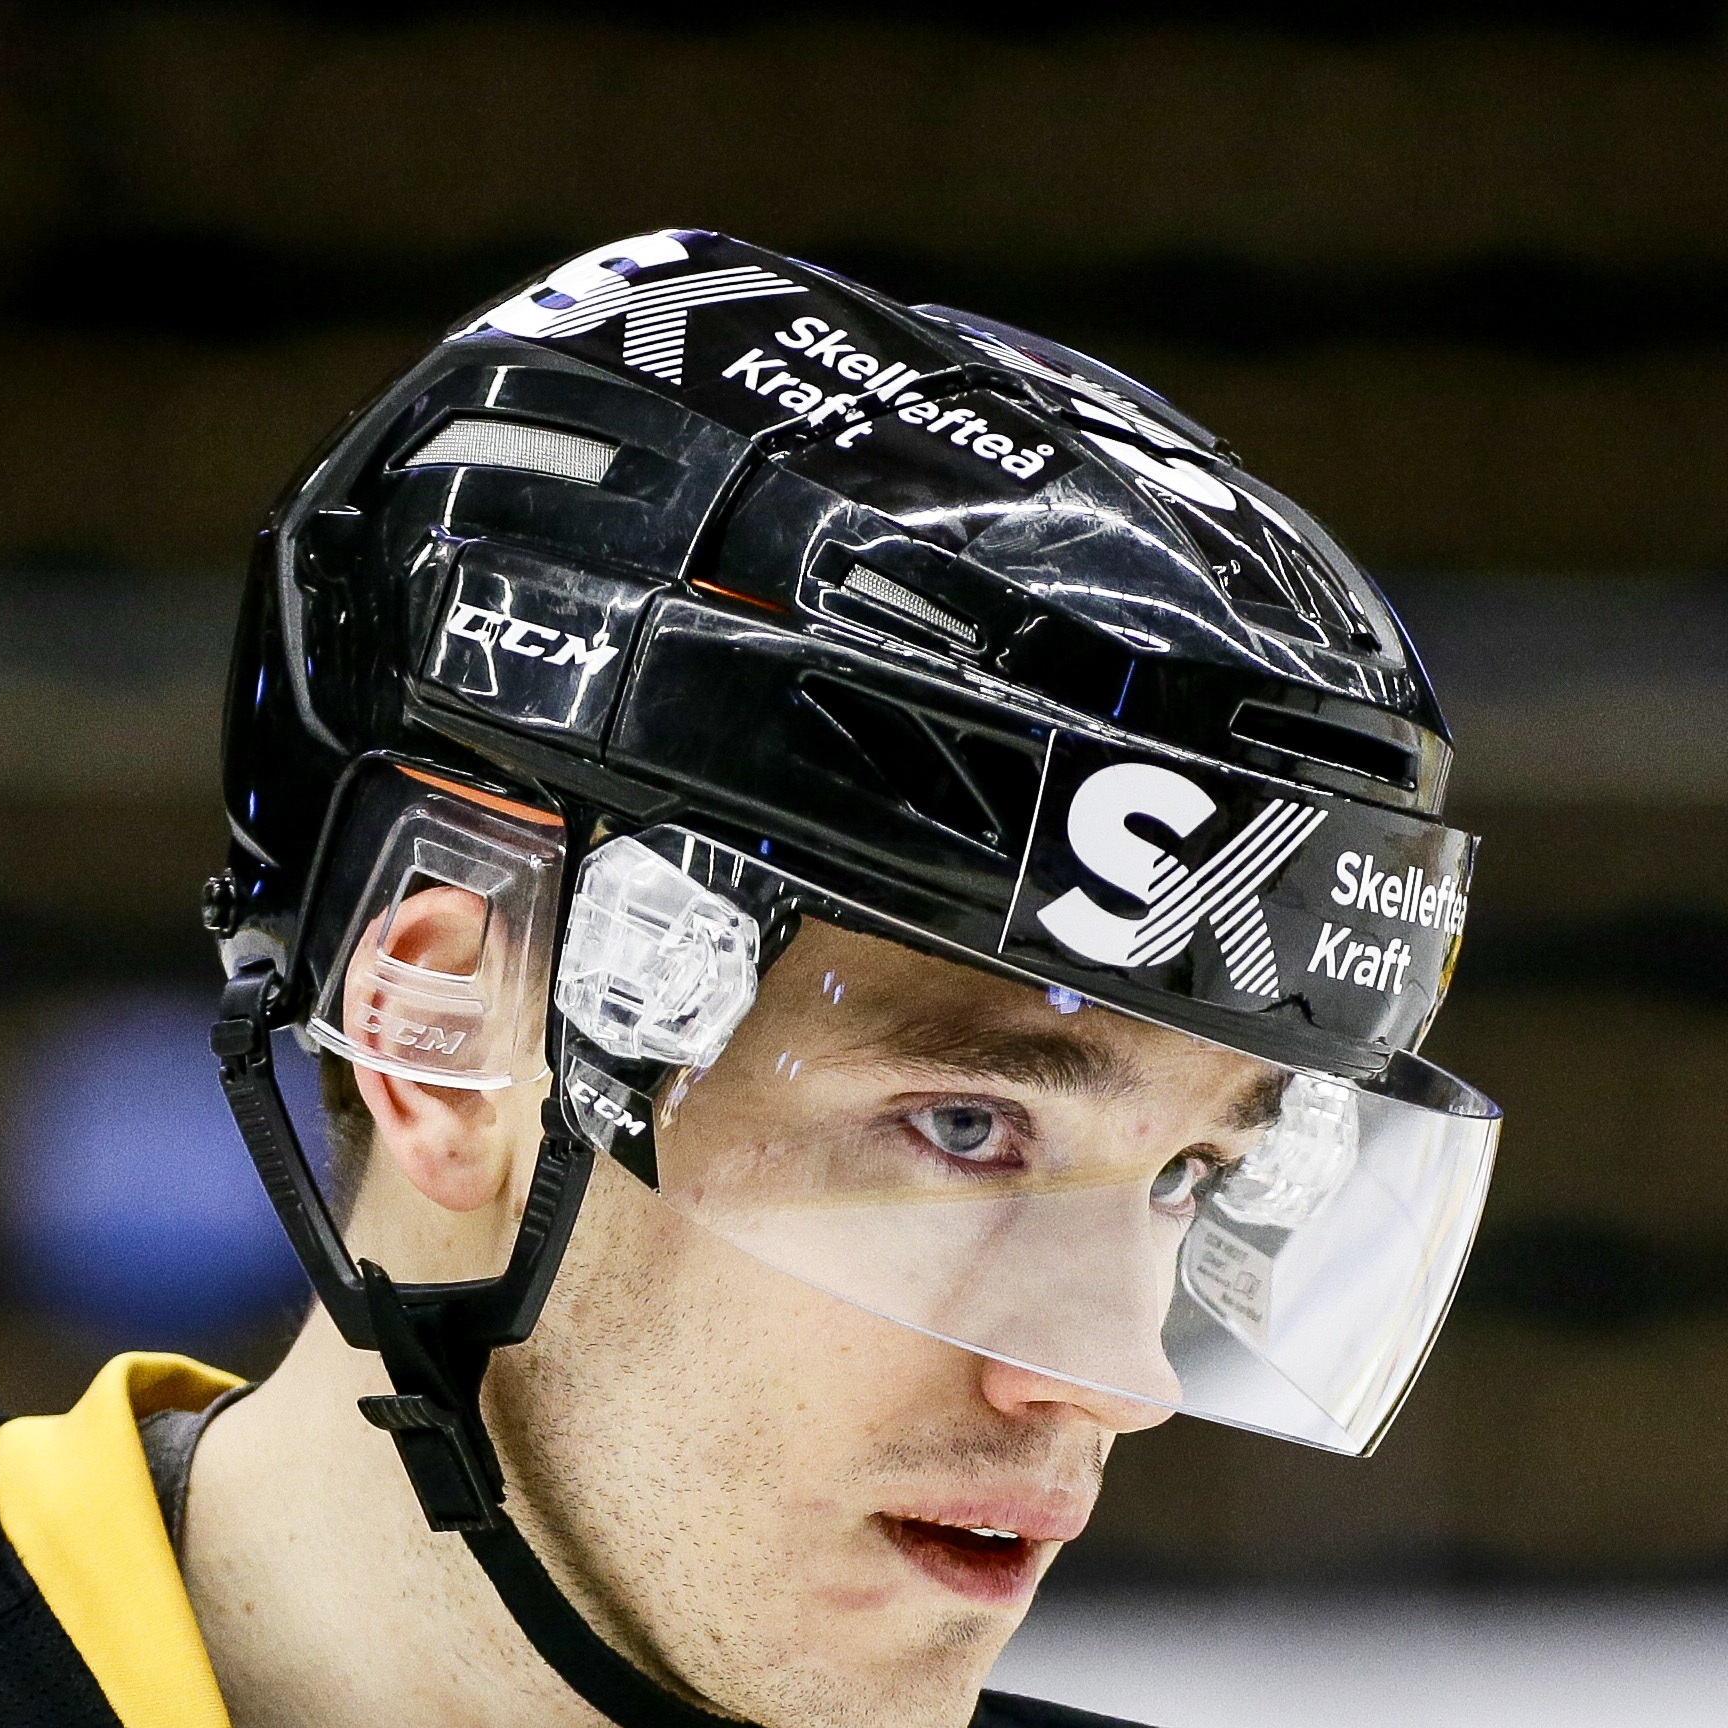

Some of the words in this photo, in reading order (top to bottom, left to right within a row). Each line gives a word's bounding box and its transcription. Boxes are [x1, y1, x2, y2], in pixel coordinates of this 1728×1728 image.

[721, 347, 873, 449] Kraft
[774, 316, 1055, 480] Skellefteå
[446, 601, 620, 676] CCM
[1306, 922, 1412, 996] Kraft
[571, 1078, 647, 1137] CCM
